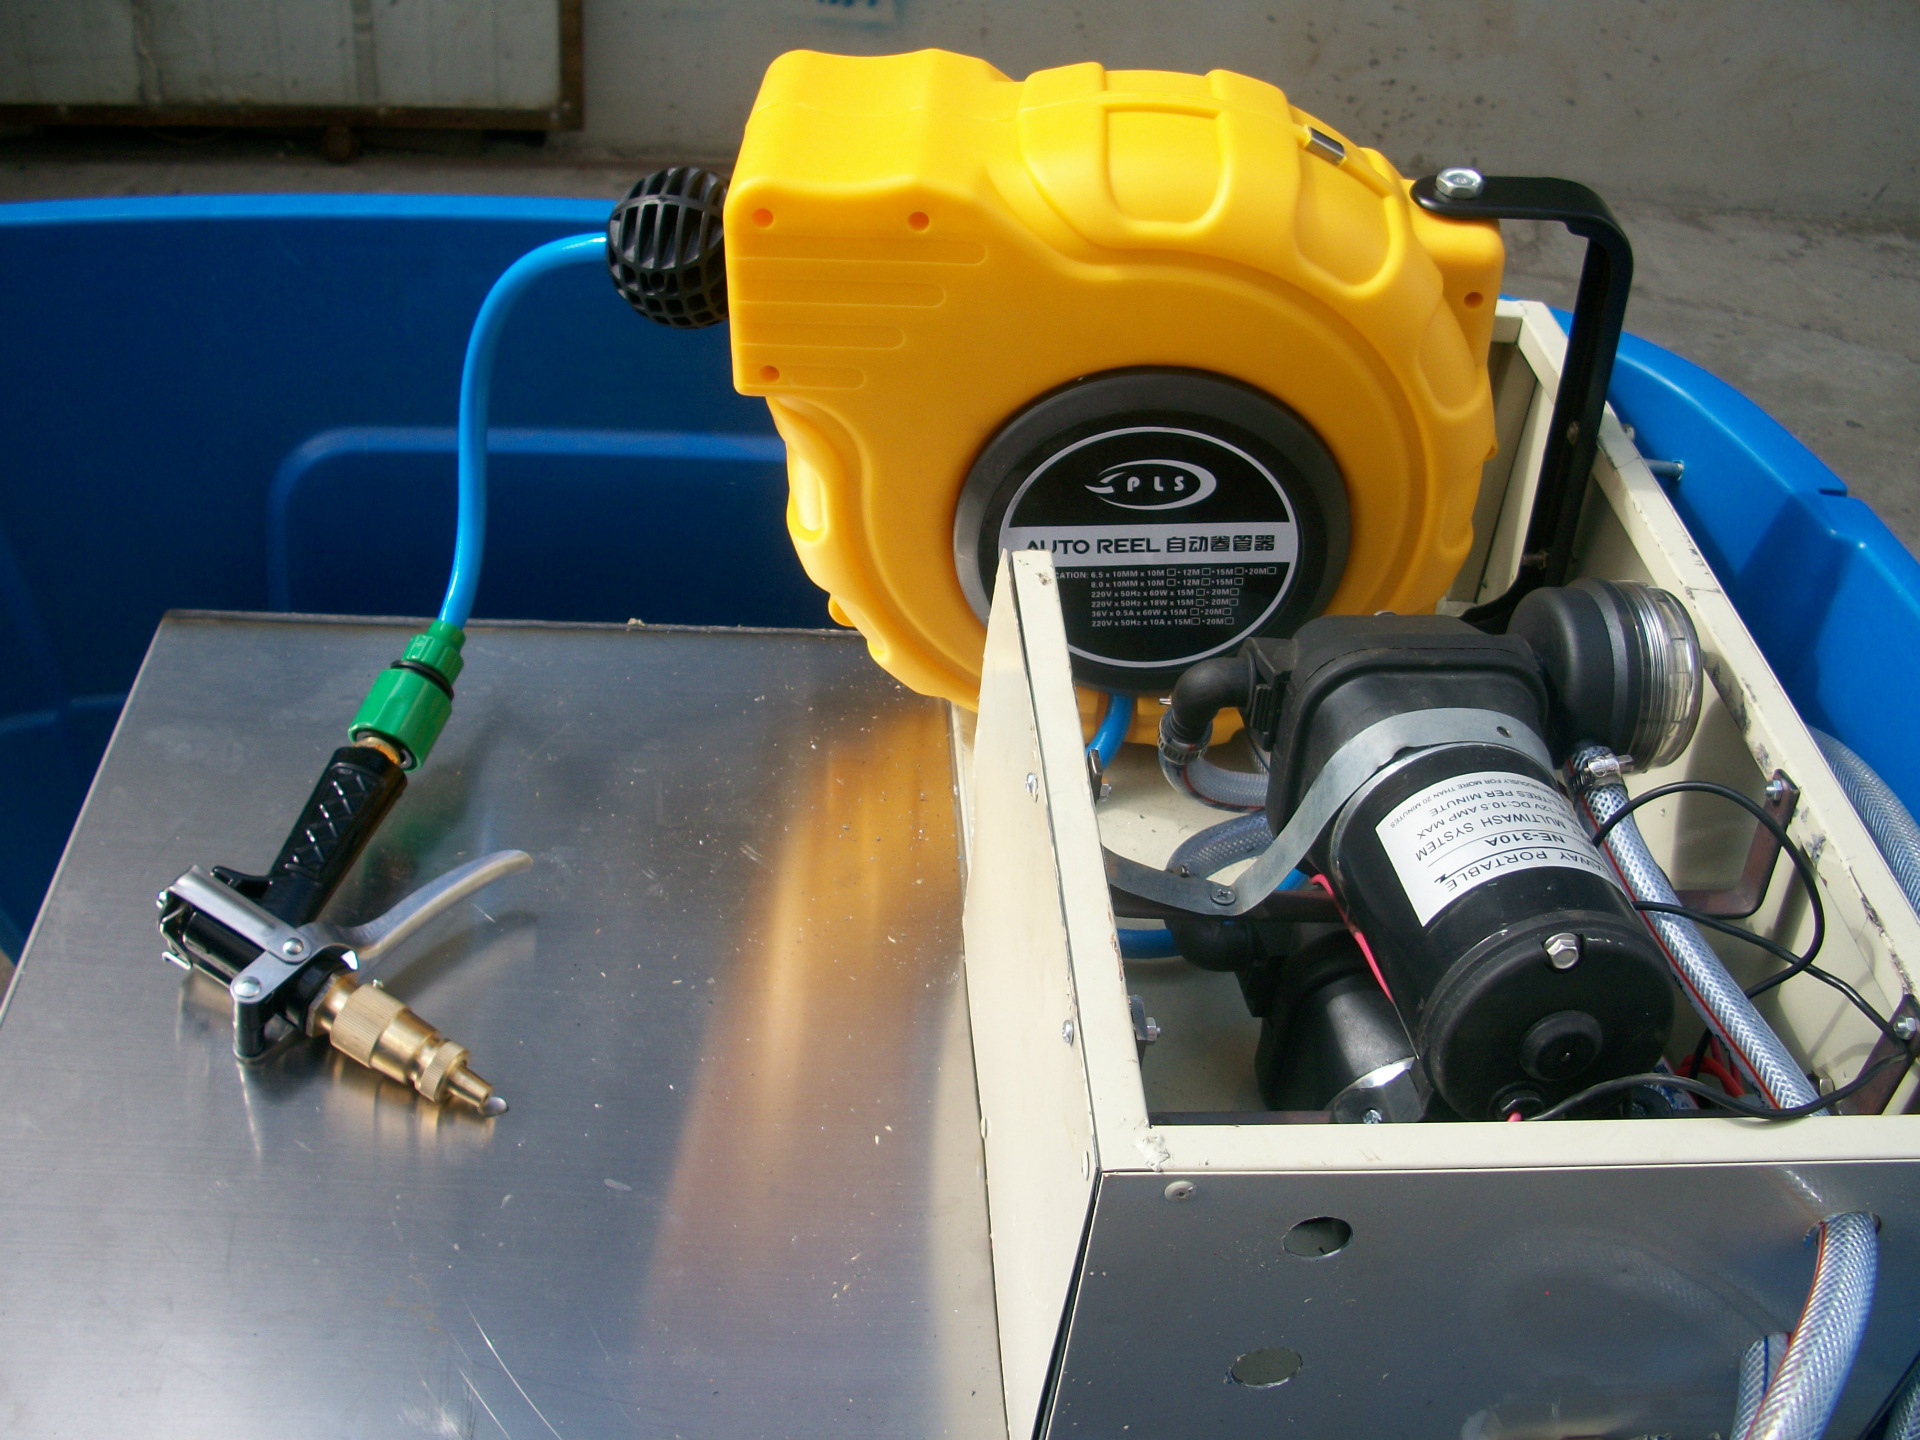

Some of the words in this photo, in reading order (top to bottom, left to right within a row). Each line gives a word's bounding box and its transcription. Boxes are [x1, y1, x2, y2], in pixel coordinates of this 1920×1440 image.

[1027, 540, 1090, 554] AUTO
[1097, 538, 1161, 554] REEL
[1433, 786, 1454, 799] THAN
[1458, 780, 1482, 790] MORE
[1422, 796, 1432, 804] 20
[1484, 790, 1513, 798] PER
[1430, 792, 1482, 817] MINUTE
[1390, 803, 1422, 829] MINUTES
[1448, 806, 1477, 822] AMP
[1480, 813, 1566, 829] MULTIWASH
[1416, 819, 1445, 840] MAX
[1415, 822, 1474, 861] SYSTEM
[1484, 832, 1566, 847] NE-310A
[1446, 851, 1547, 892] PORTABLE
